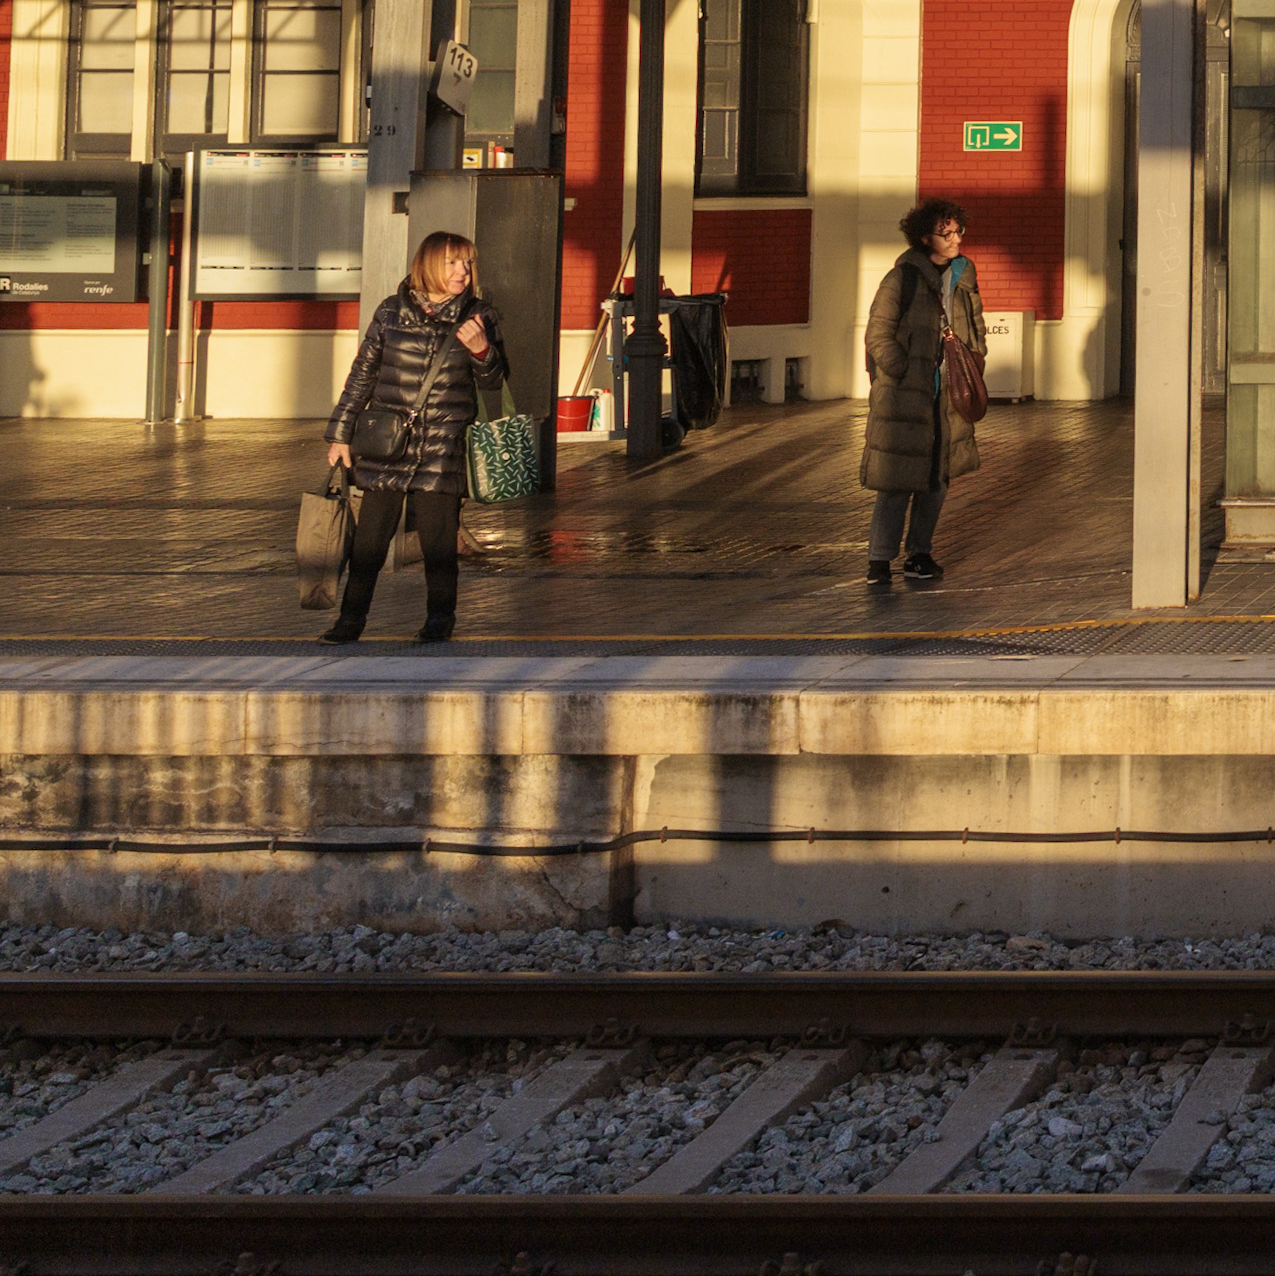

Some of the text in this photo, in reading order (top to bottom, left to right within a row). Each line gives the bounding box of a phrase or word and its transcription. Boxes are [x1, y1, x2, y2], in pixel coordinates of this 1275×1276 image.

[450, 47, 473, 78] 113
[0, 278, 49, 291] R Rodalies
[84, 284, 114, 296] renfe
[987, 325, 1010, 335] LCES
